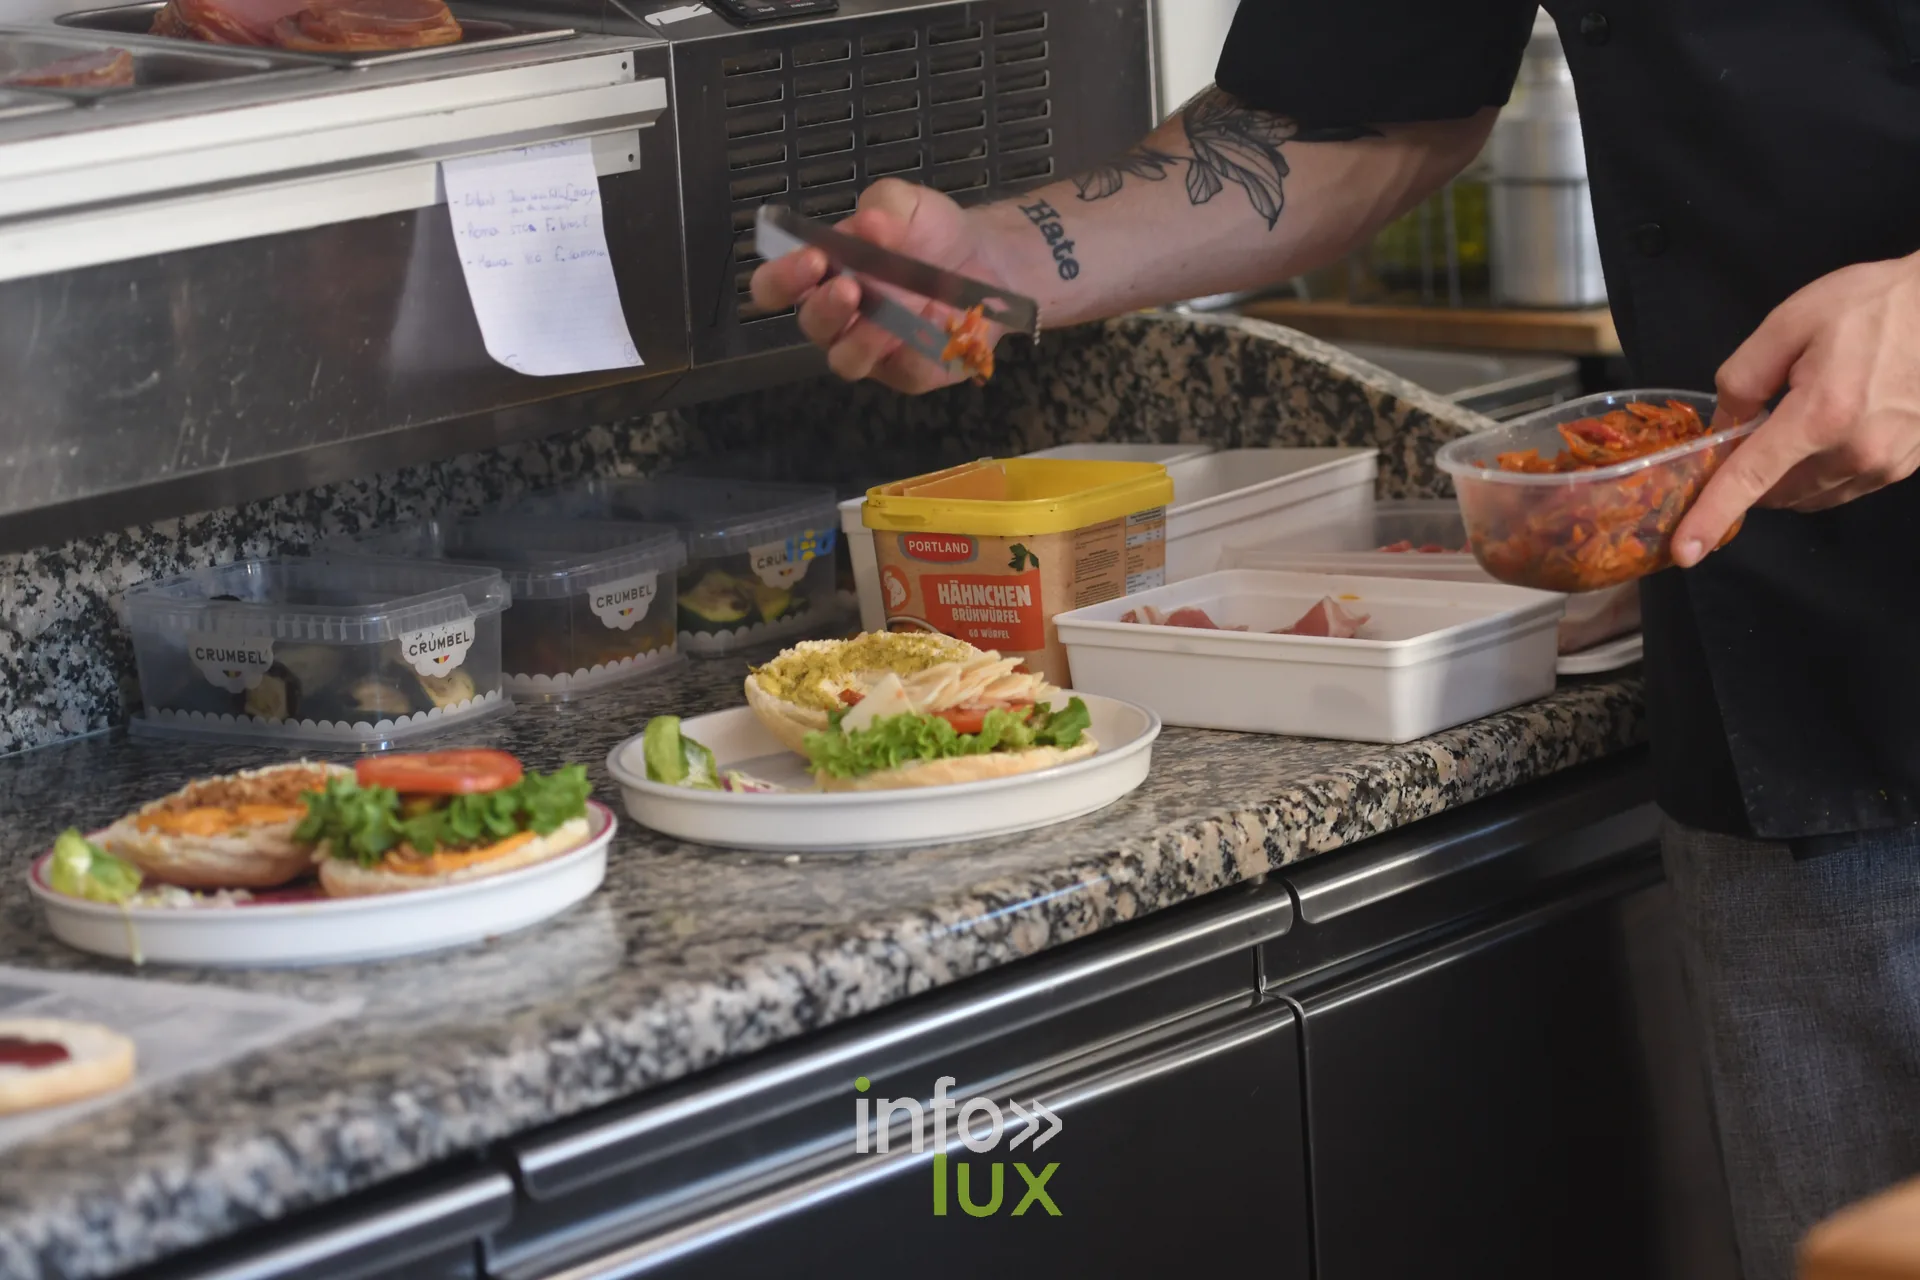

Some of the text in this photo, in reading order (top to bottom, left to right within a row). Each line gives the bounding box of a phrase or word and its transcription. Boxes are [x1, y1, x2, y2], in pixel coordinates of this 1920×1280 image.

[1018, 199, 1079, 281] Hate
[908, 540, 969, 554] PORTLAND
[596, 584, 653, 609] CRUMBEL
[937, 580, 1032, 607] HÄHNCHEN
[951, 606, 1021, 624] BRÜHWÜRFEL
[408, 630, 471, 657] CRUMBEL
[980, 627, 1010, 639] WÜRFEL
[194, 646, 268, 666] CRUMBEL
